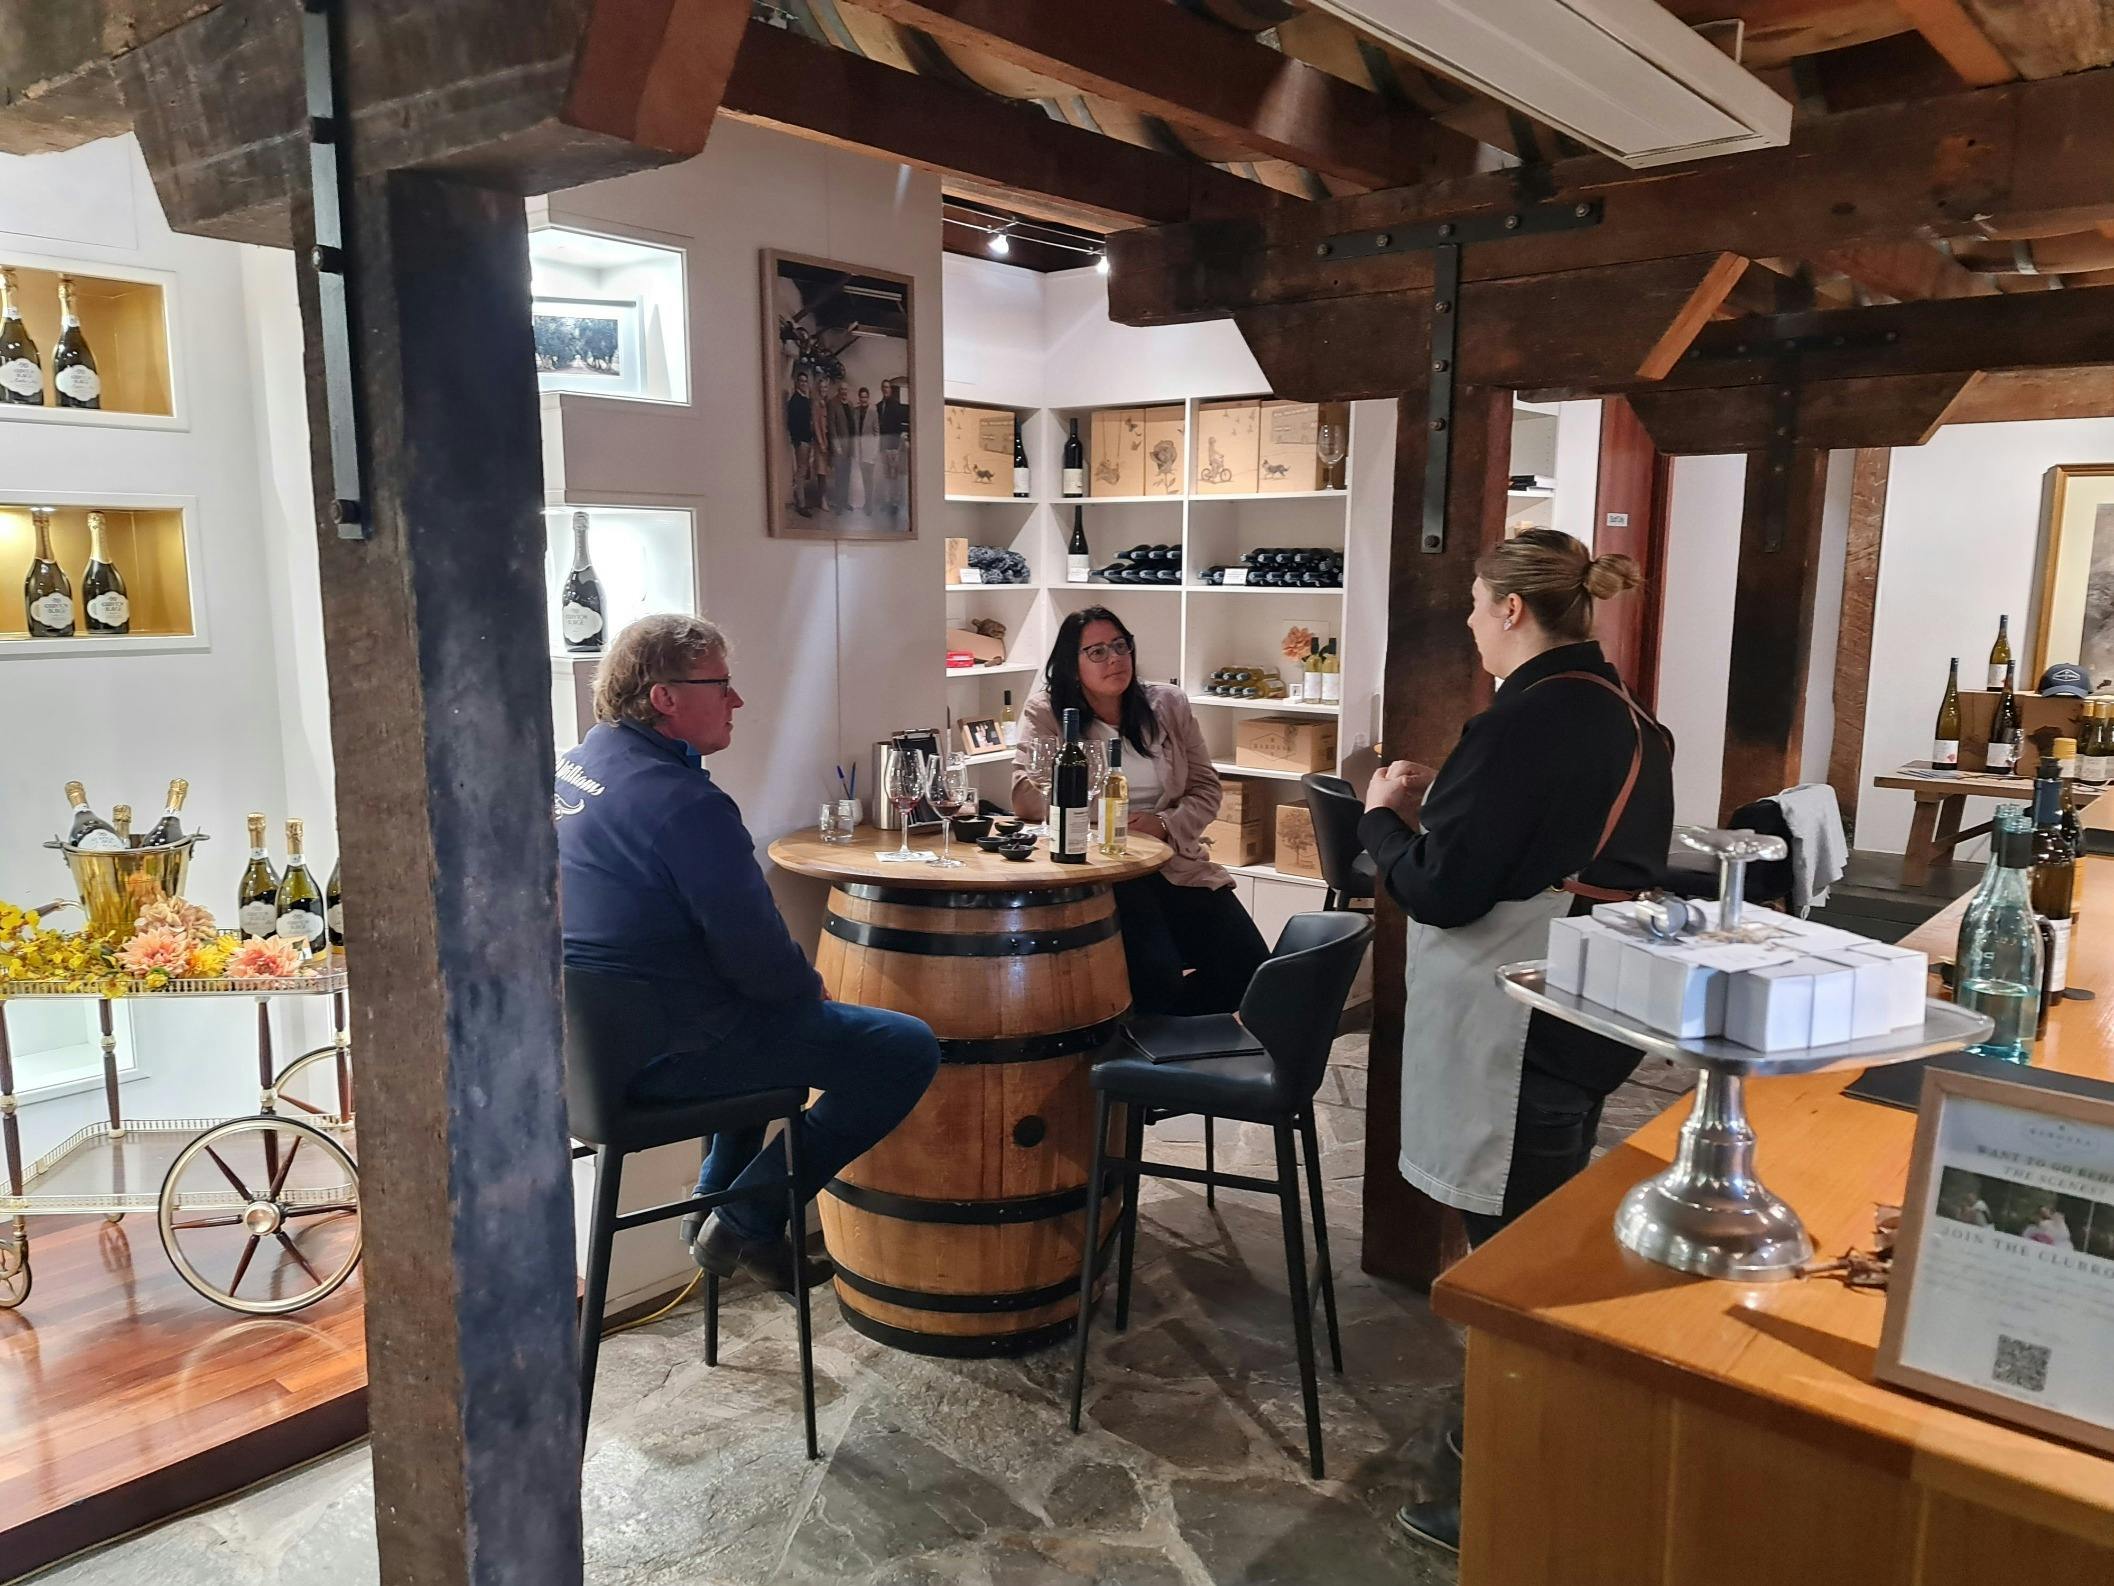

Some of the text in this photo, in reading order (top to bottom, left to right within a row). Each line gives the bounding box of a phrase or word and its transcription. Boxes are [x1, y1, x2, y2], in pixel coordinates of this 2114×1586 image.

[2003, 1165, 2031, 1181] THE
[1941, 1226, 1983, 1245] JOIN
[1992, 1237, 2030, 1258] THE
